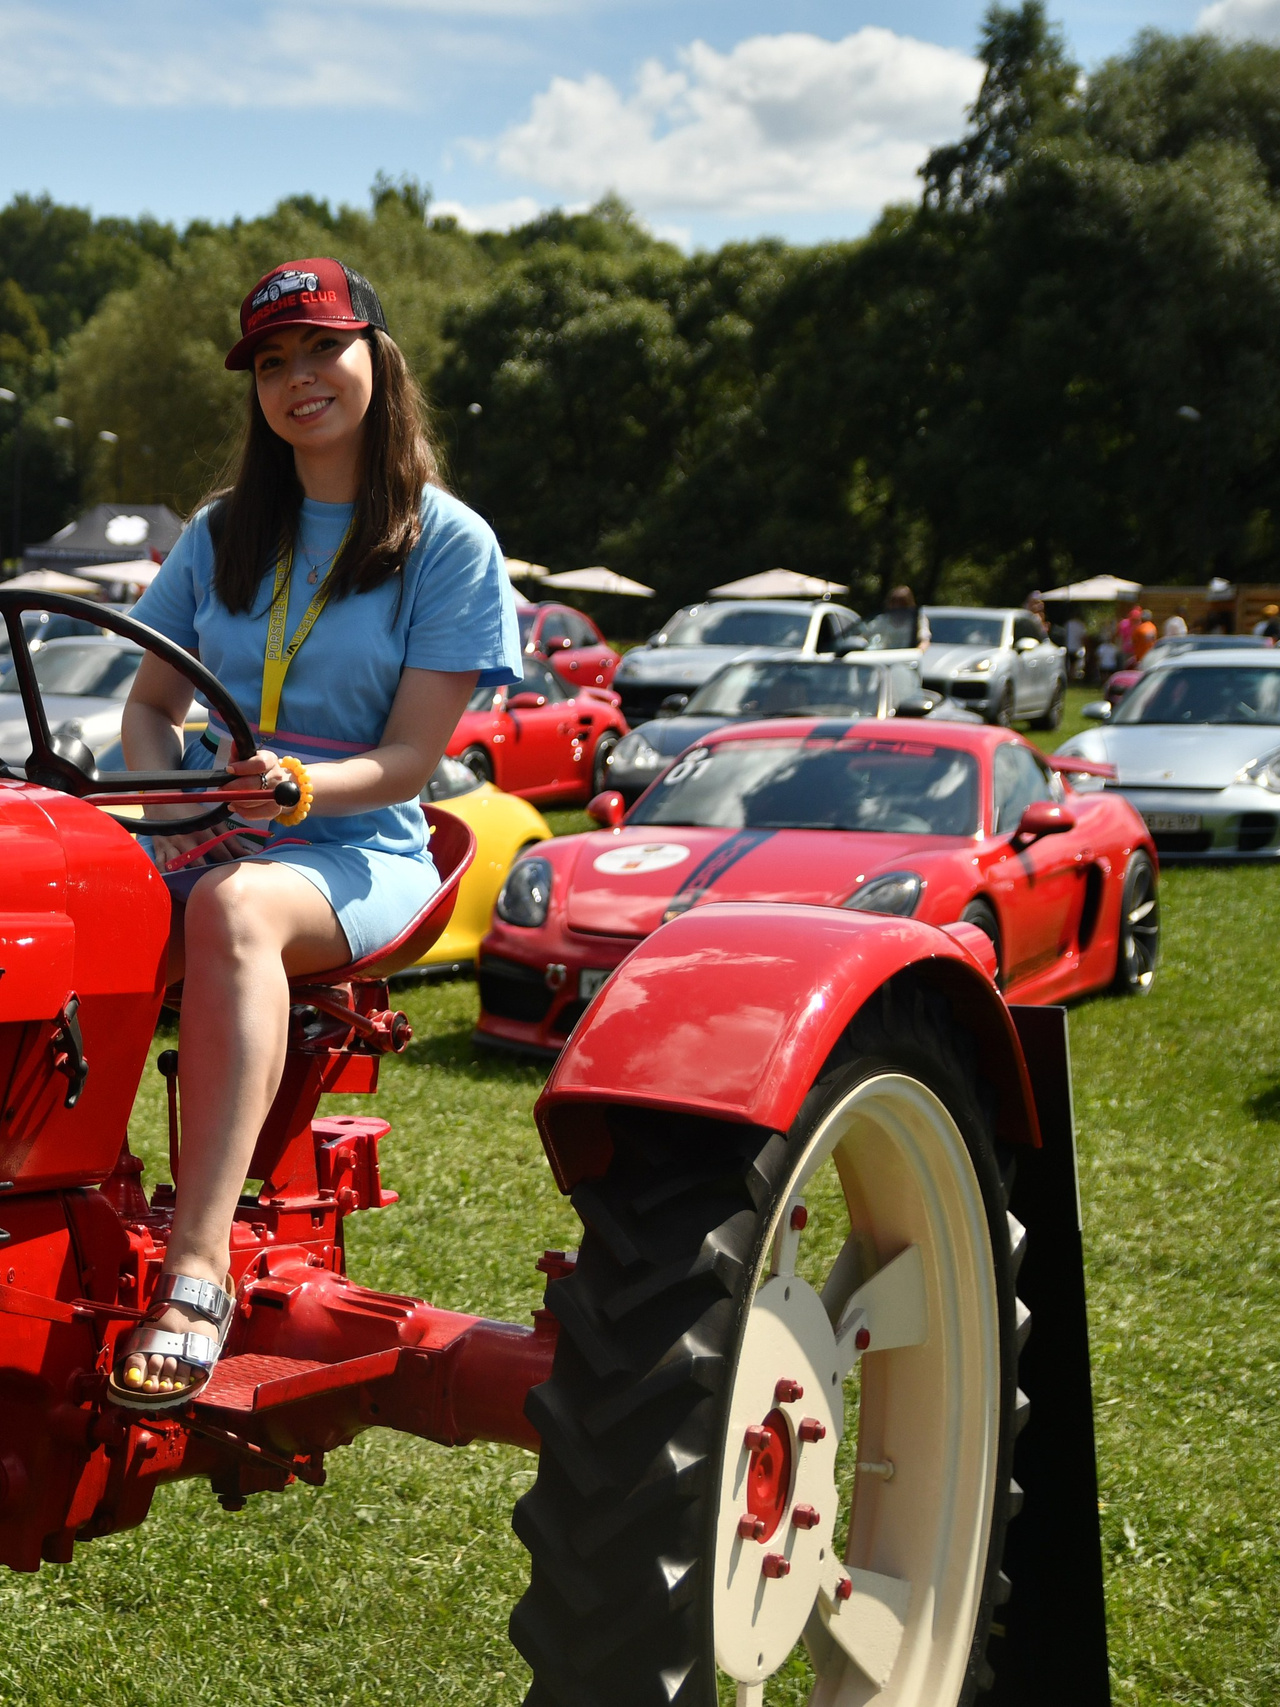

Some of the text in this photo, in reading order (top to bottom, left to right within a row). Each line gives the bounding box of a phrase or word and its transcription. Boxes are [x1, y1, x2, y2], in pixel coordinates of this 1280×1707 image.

[248, 291, 337, 328] PORSCHE CLUB
[276, 571, 289, 601] CLUB
[267, 603, 286, 660] PORSCHE
[282, 612, 316, 663] FESTIVAL
